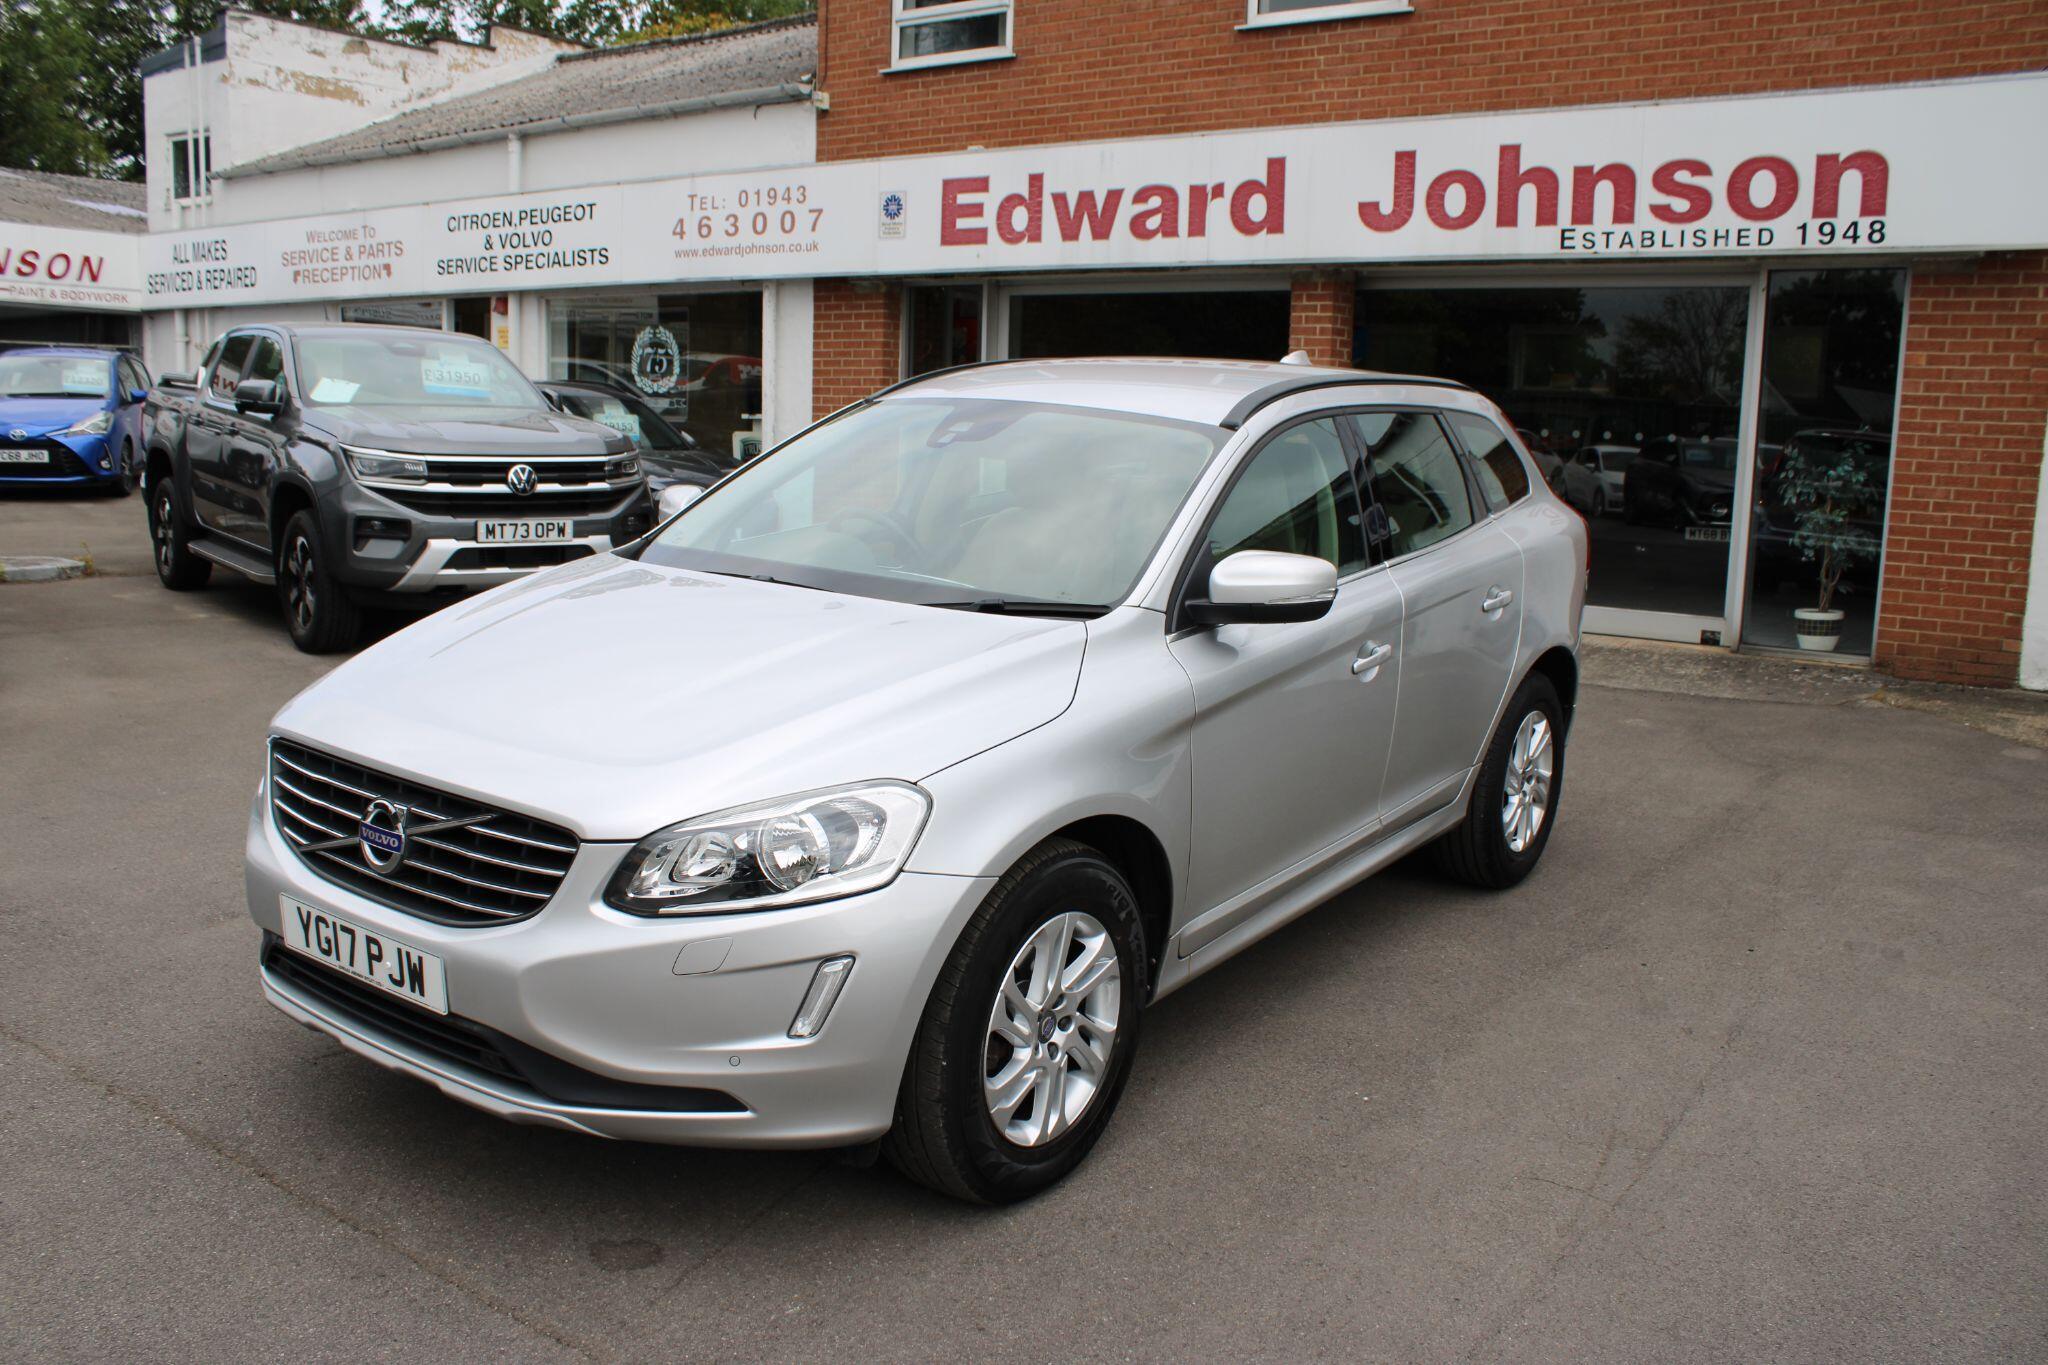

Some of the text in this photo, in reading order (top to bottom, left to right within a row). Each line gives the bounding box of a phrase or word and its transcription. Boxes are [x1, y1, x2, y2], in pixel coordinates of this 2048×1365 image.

[688, 185, 807, 212] TEL: 01943
[940, 143, 1890, 247] Edward Johnson
[672, 208, 824, 240] 463007
[1559, 219, 1887, 250] ESTABLISHED 1948
[172, 239, 228, 264] ALL MAKES
[281, 240, 404, 268] SERVICE & PARTS
[484, 230, 552, 251] & VOLVO
[674, 241, 819, 260] www.edwardjohnson.co.uk
[301, 264, 382, 285] RECEPTION
[437, 247, 609, 276] SERVICE SPECIALISTS
[9, 284, 129, 304] PAINT & BODYWORK
[148, 266, 257, 295] SERVICED & REPAIRED
[643, 347, 668, 374] 75
[424, 368, 481, 385] £31950
[485, 522, 567, 540] MT73 OPW
[361, 826, 399, 848] VOLVO
[297, 906, 425, 997] YG17 PJW
